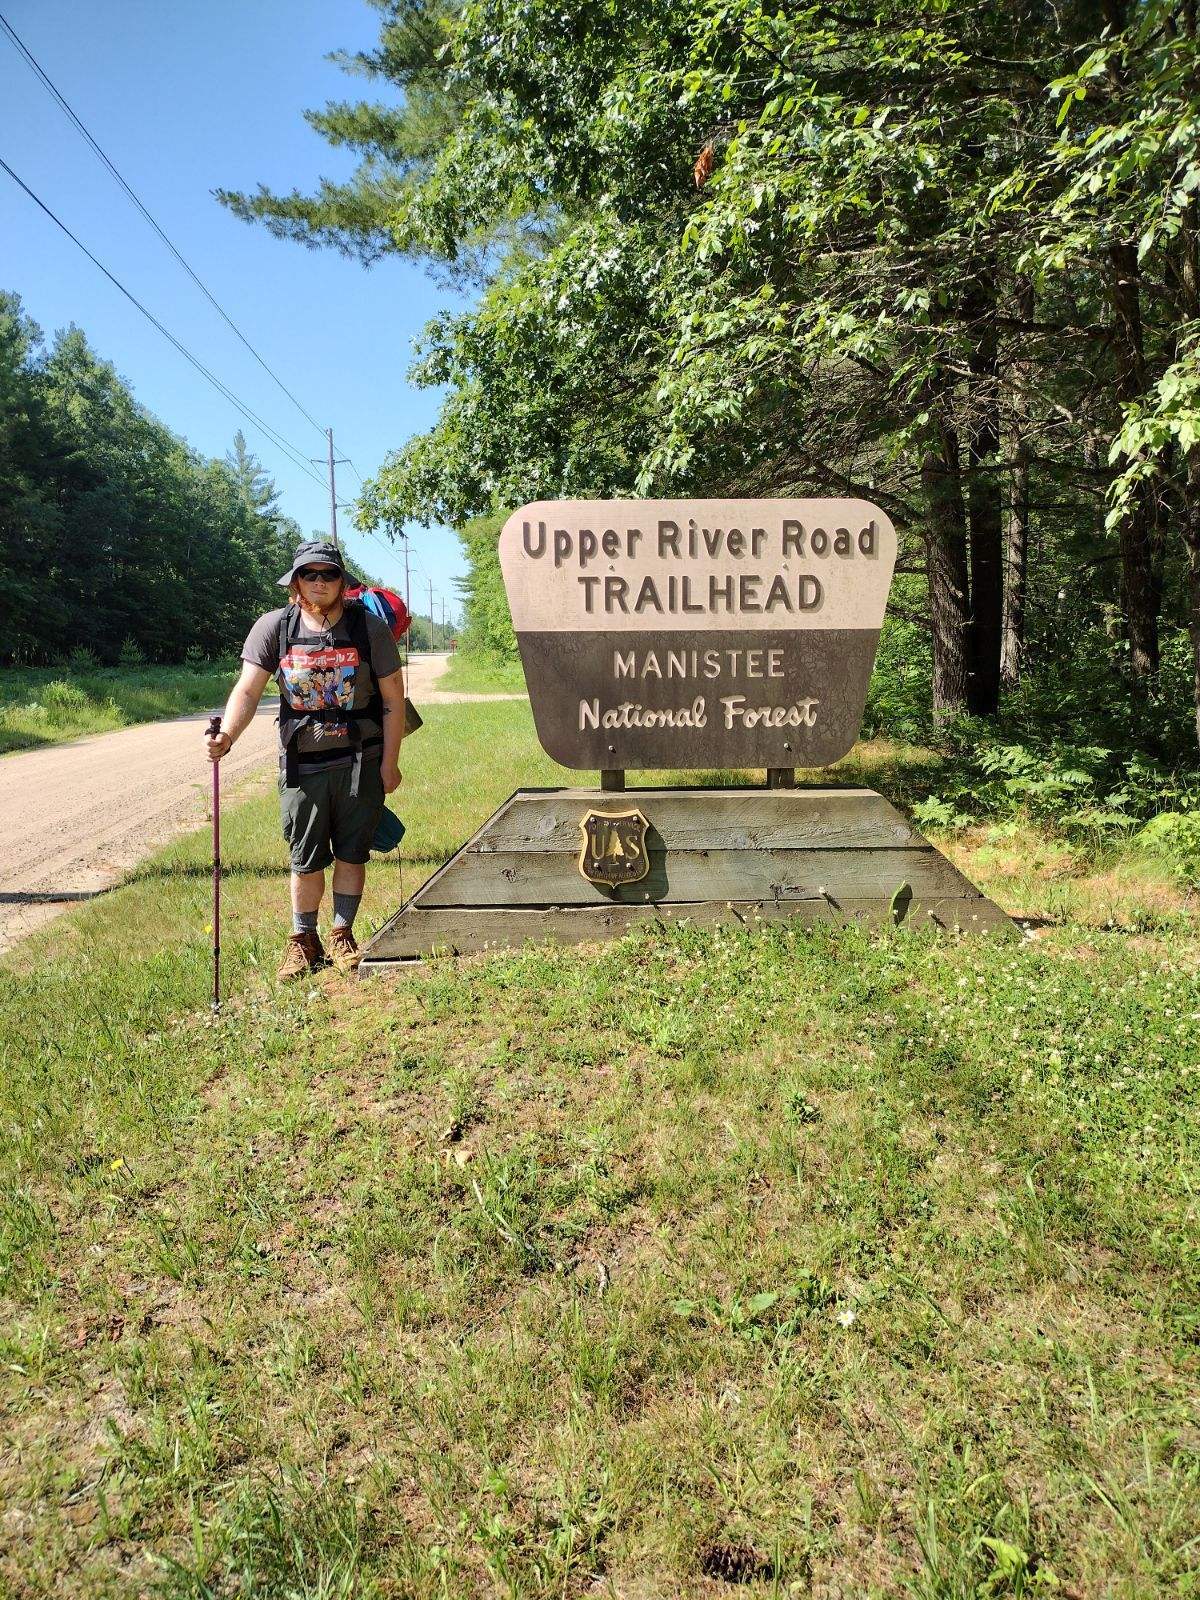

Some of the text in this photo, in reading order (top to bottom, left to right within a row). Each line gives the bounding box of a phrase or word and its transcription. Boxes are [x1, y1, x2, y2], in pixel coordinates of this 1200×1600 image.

[522, 518, 879, 568] Upper River Road
[578, 574, 824, 614] TRAILHEAD
[613, 648, 786, 679] MANISTEE
[578, 694, 820, 730] National Forest
[591, 834, 640, 860] U S
